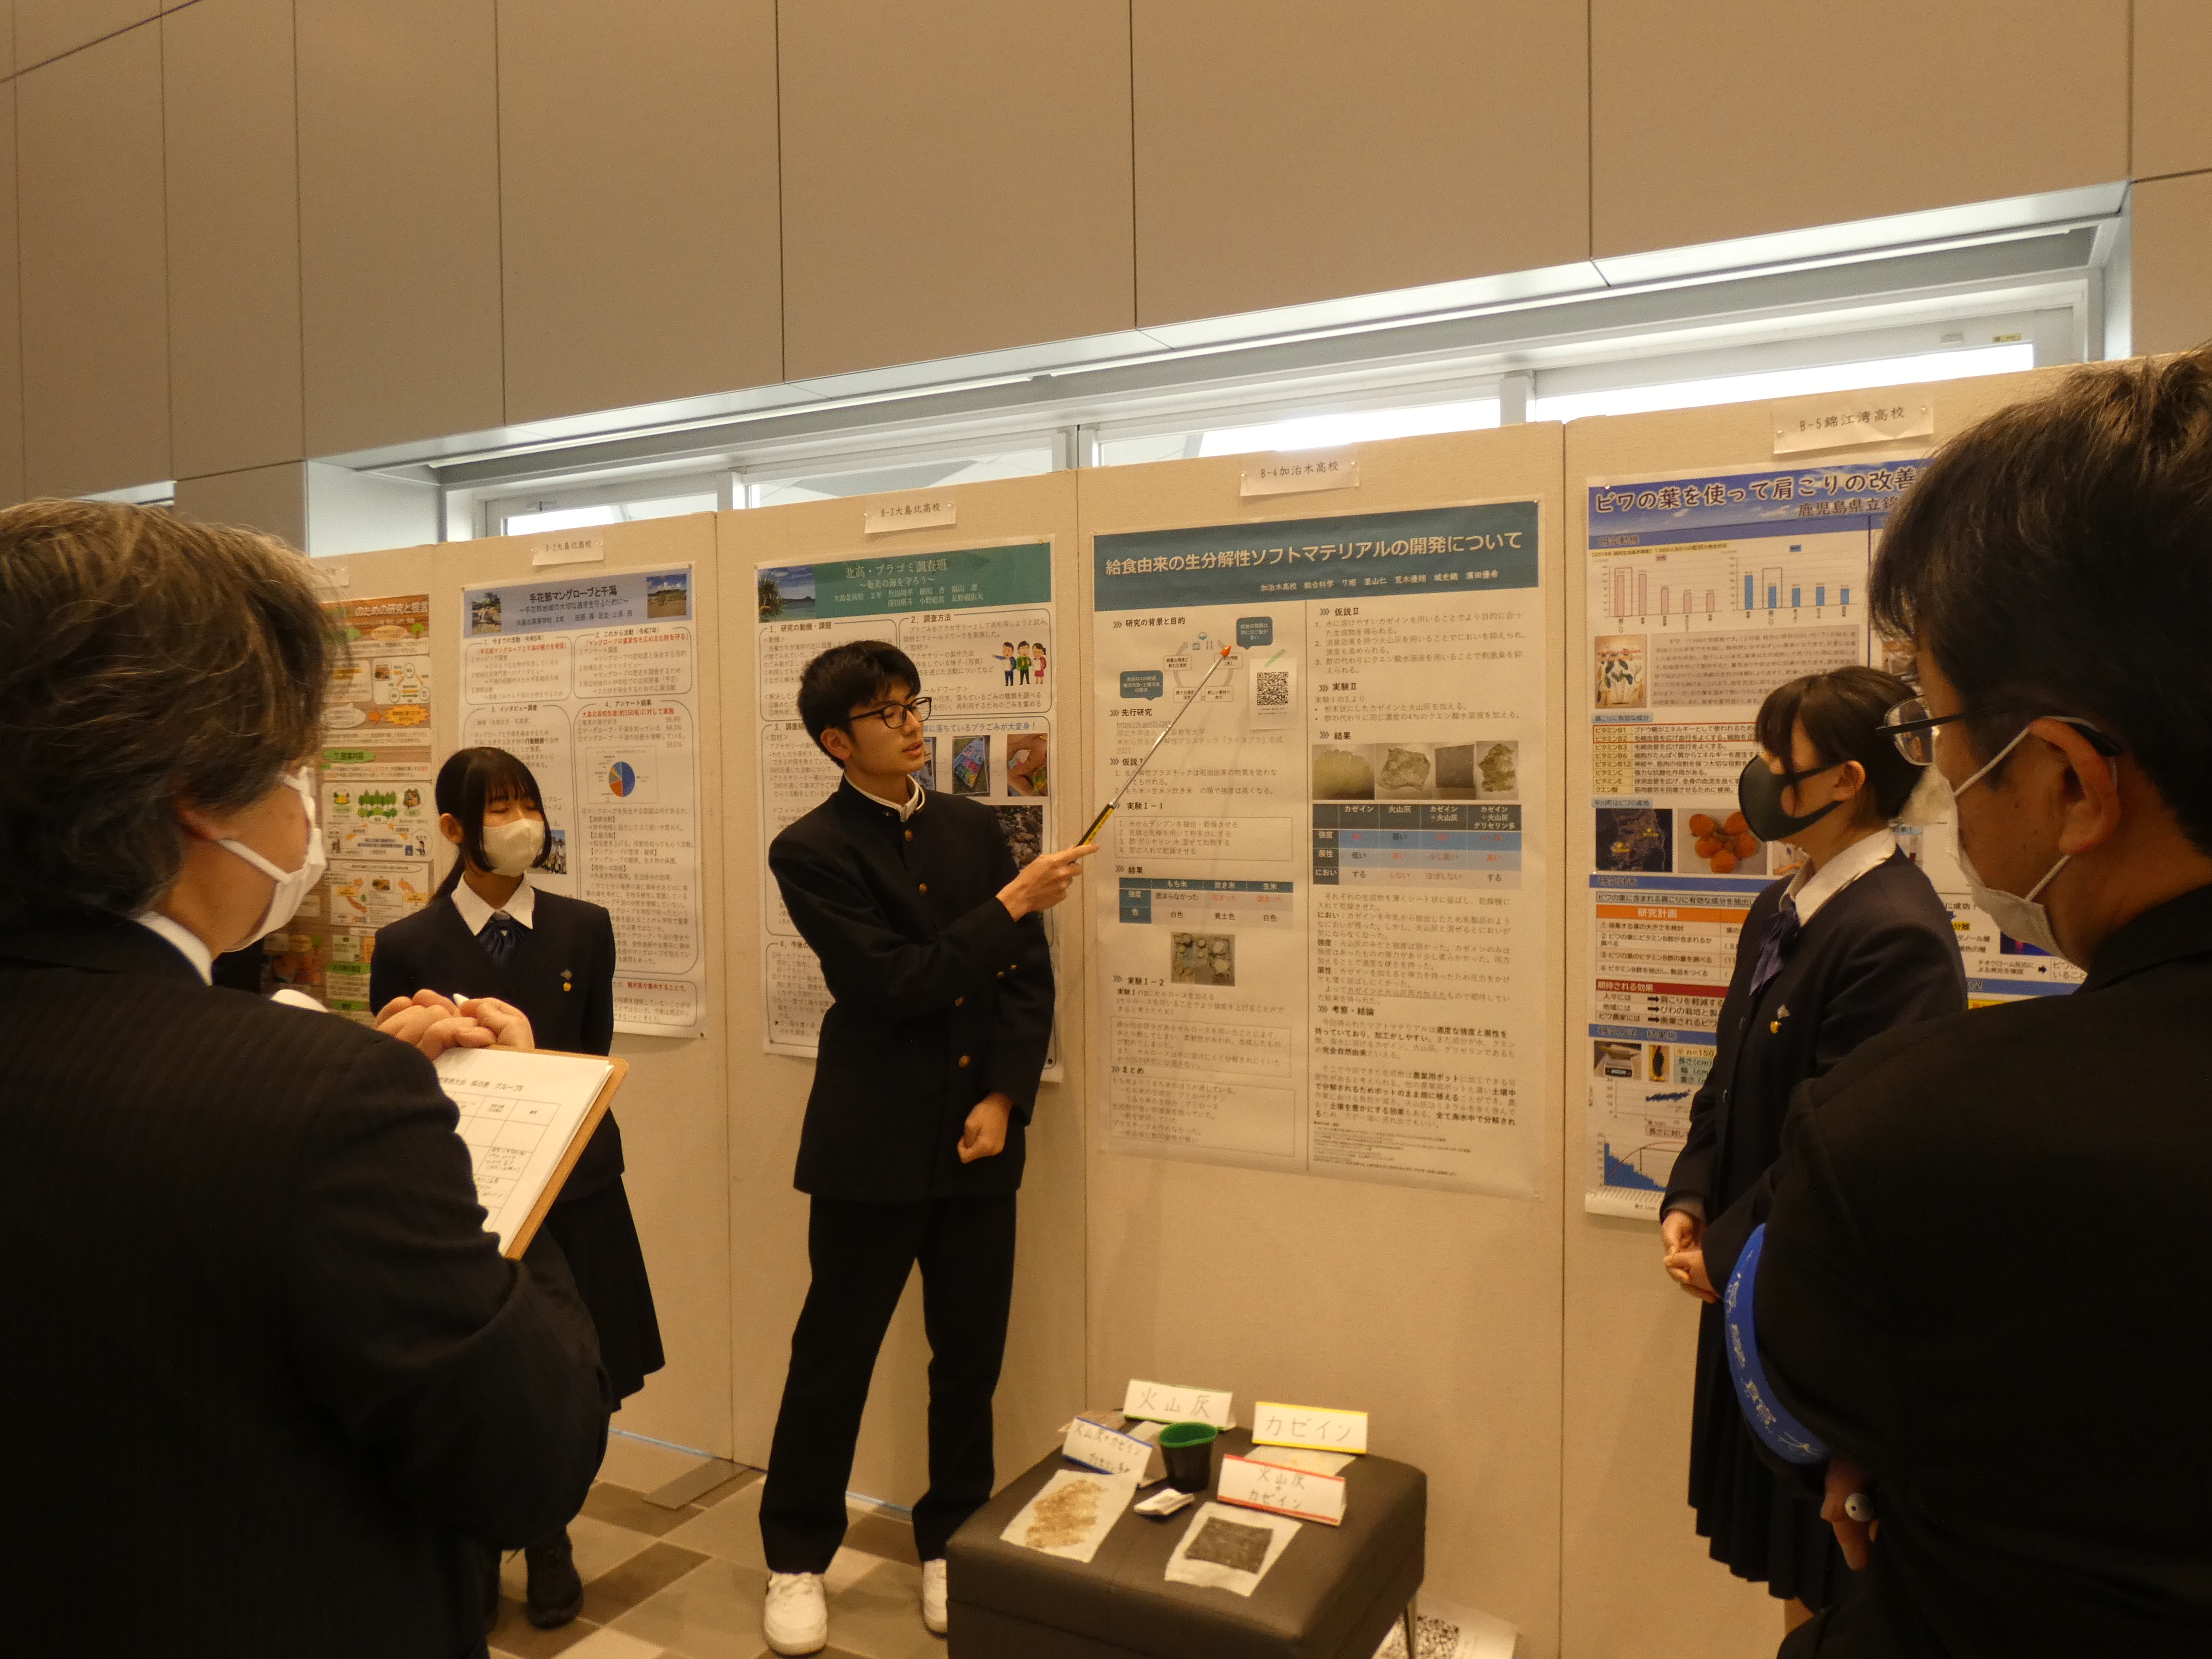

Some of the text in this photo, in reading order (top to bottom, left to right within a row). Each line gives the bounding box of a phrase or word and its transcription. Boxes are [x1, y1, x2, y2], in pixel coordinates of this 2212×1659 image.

[1800, 407, 1905, 432] B-5錦江湾高校
[1261, 461, 1339, 478] B-4加治木高校
[1595, 466, 1917, 514] ビワの葉を使って肩こりの改善
[881, 503, 941, 518] B-3大島北高校
[1105, 531, 1523, 576] 給食由来の生分解性ソフトマテリアルの開発について
[923, 614, 951, 623] 調査方法
[1125, 616, 1186, 628] 研究の背景と目的
[1121, 708, 1152, 717] 先行研究
[1334, 731, 1351, 740] 結果
[1344, 805, 1374, 813] カゼイン
[1388, 805, 1412, 814] 火山灰
[1128, 866, 1143, 874] 結果
[1315, 869, 1338, 877] におい
[1352, 870, 1366, 878] する
[1486, 873, 1502, 882] する
[1331, 1006, 1375, 1017] 考察・結論
[1122, 1065, 1144, 1074] まとめ
[1265, 1415, 1354, 1442] カゼイン
